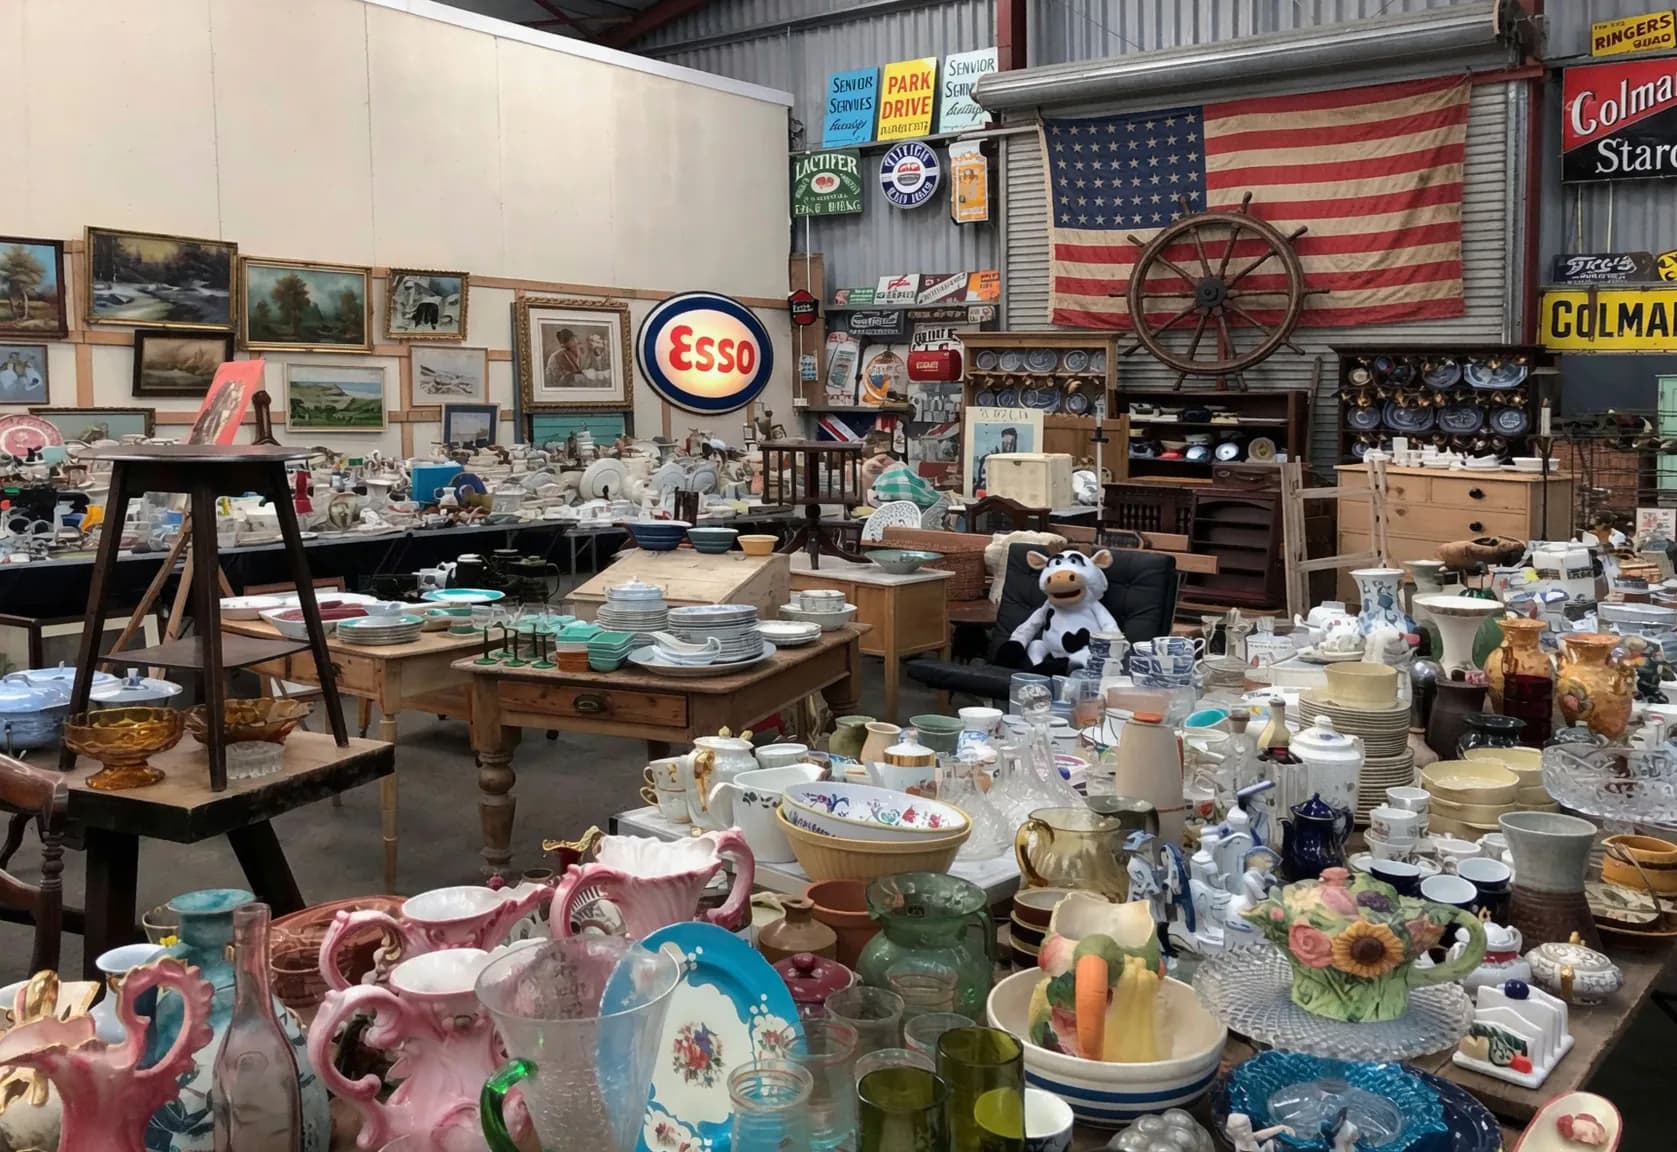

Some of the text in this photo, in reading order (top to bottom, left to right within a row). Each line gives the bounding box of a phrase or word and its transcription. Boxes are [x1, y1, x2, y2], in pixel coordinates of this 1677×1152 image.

[1595, 14, 1672, 50] RINGERS
[888, 71, 931, 95] PARK
[881, 96, 931, 120] DRIVE
[1571, 72, 1677, 136] Colma
[795, 153, 860, 182] LACTIFER
[1551, 300, 1677, 338] COLMA
